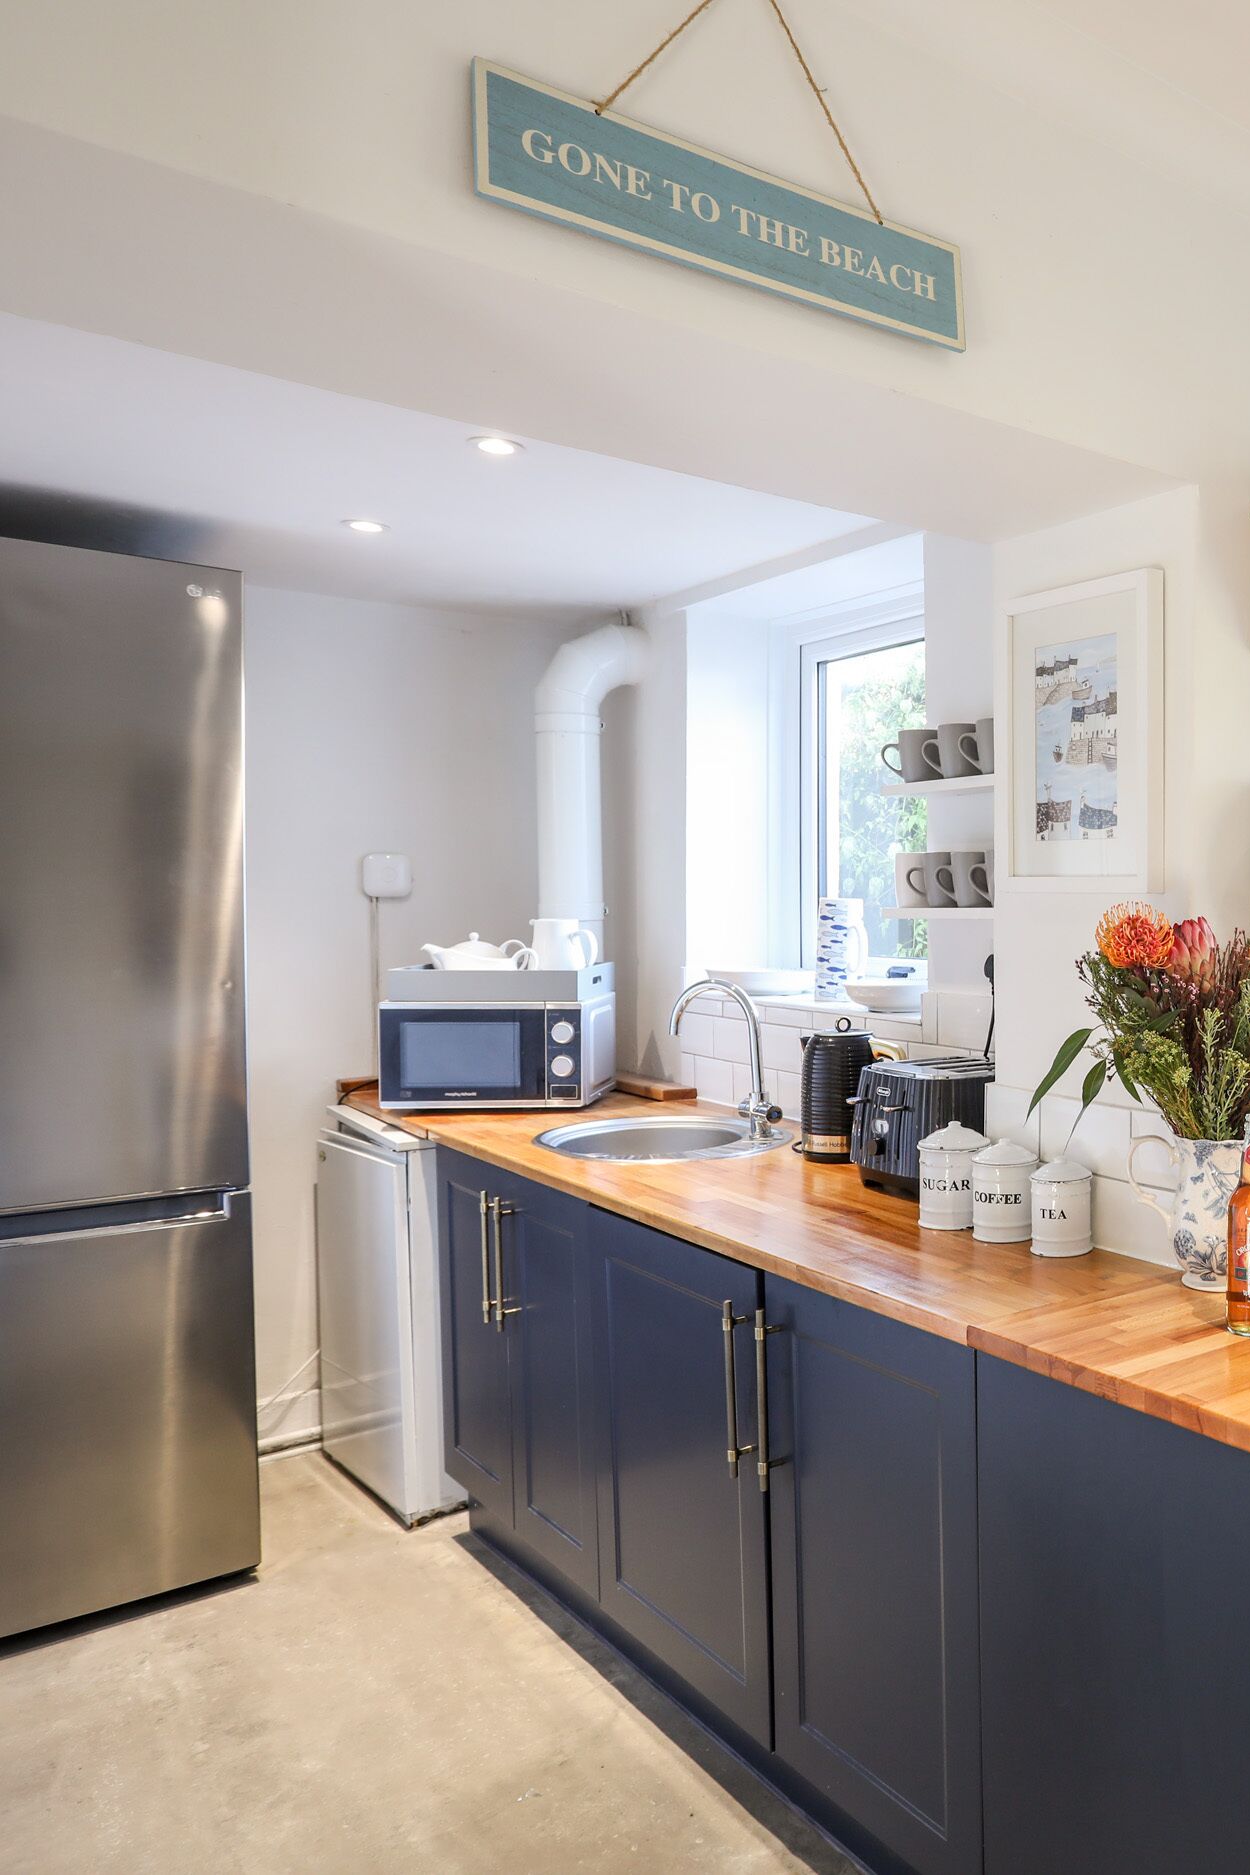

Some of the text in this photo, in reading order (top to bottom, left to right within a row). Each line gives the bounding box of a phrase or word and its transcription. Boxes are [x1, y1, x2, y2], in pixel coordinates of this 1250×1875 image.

[521, 129, 937, 301] GONE TO THE BEACH
[922, 1177, 971, 1192] SUGAR
[974, 1190, 1022, 1205] COFFEE
[1039, 1207, 1067, 1220] TEA
